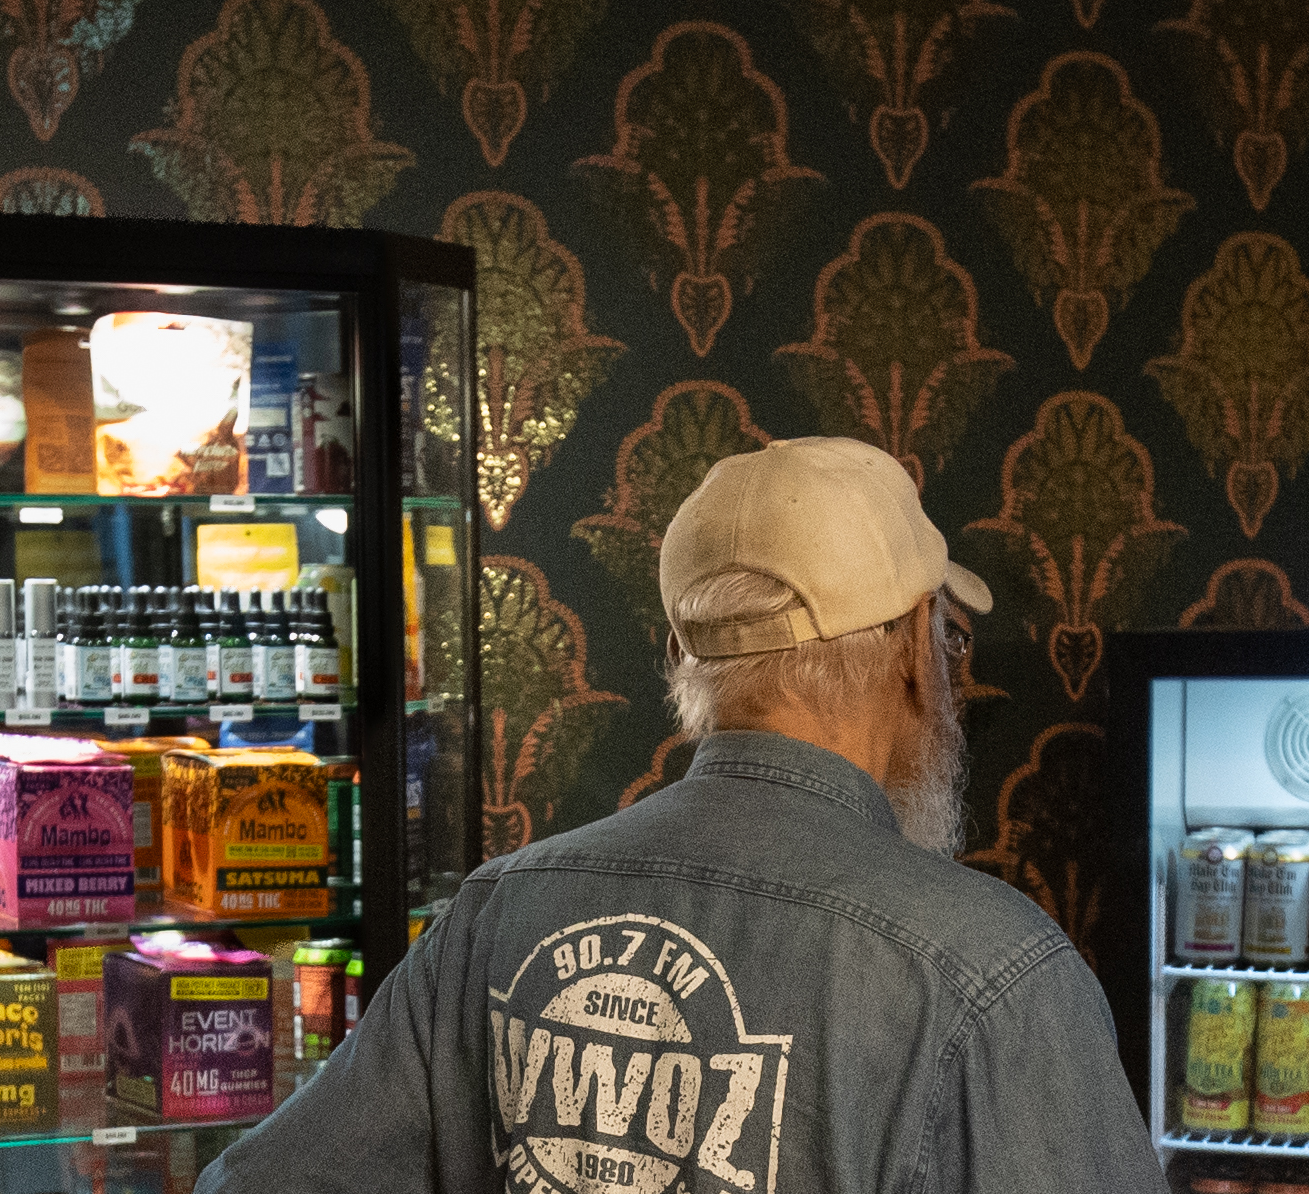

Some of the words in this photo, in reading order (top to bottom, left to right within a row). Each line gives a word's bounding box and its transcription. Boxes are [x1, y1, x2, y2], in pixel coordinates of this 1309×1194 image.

[41, 825, 111, 847] Mambo
[239, 818, 308, 842] Mambo
[25, 878, 75, 894] MIXED
[77, 876, 129, 892] BERRY
[225, 870, 321, 888] SATSUMA
[84, 898, 109, 915] THC
[256, 892, 281, 909] THC
[552, 929, 647, 981] 90.7
[652, 938, 711, 1000] FM
[181, 1008, 257, 1031] EVENT
[583, 990, 660, 1028] SINCE
[168, 1031, 270, 1056] HORIZON
[220, 1079, 267, 1092] GUMMIES
[489, 1009, 765, 1193] WWOZ
[575, 1150, 636, 1187] 1980
